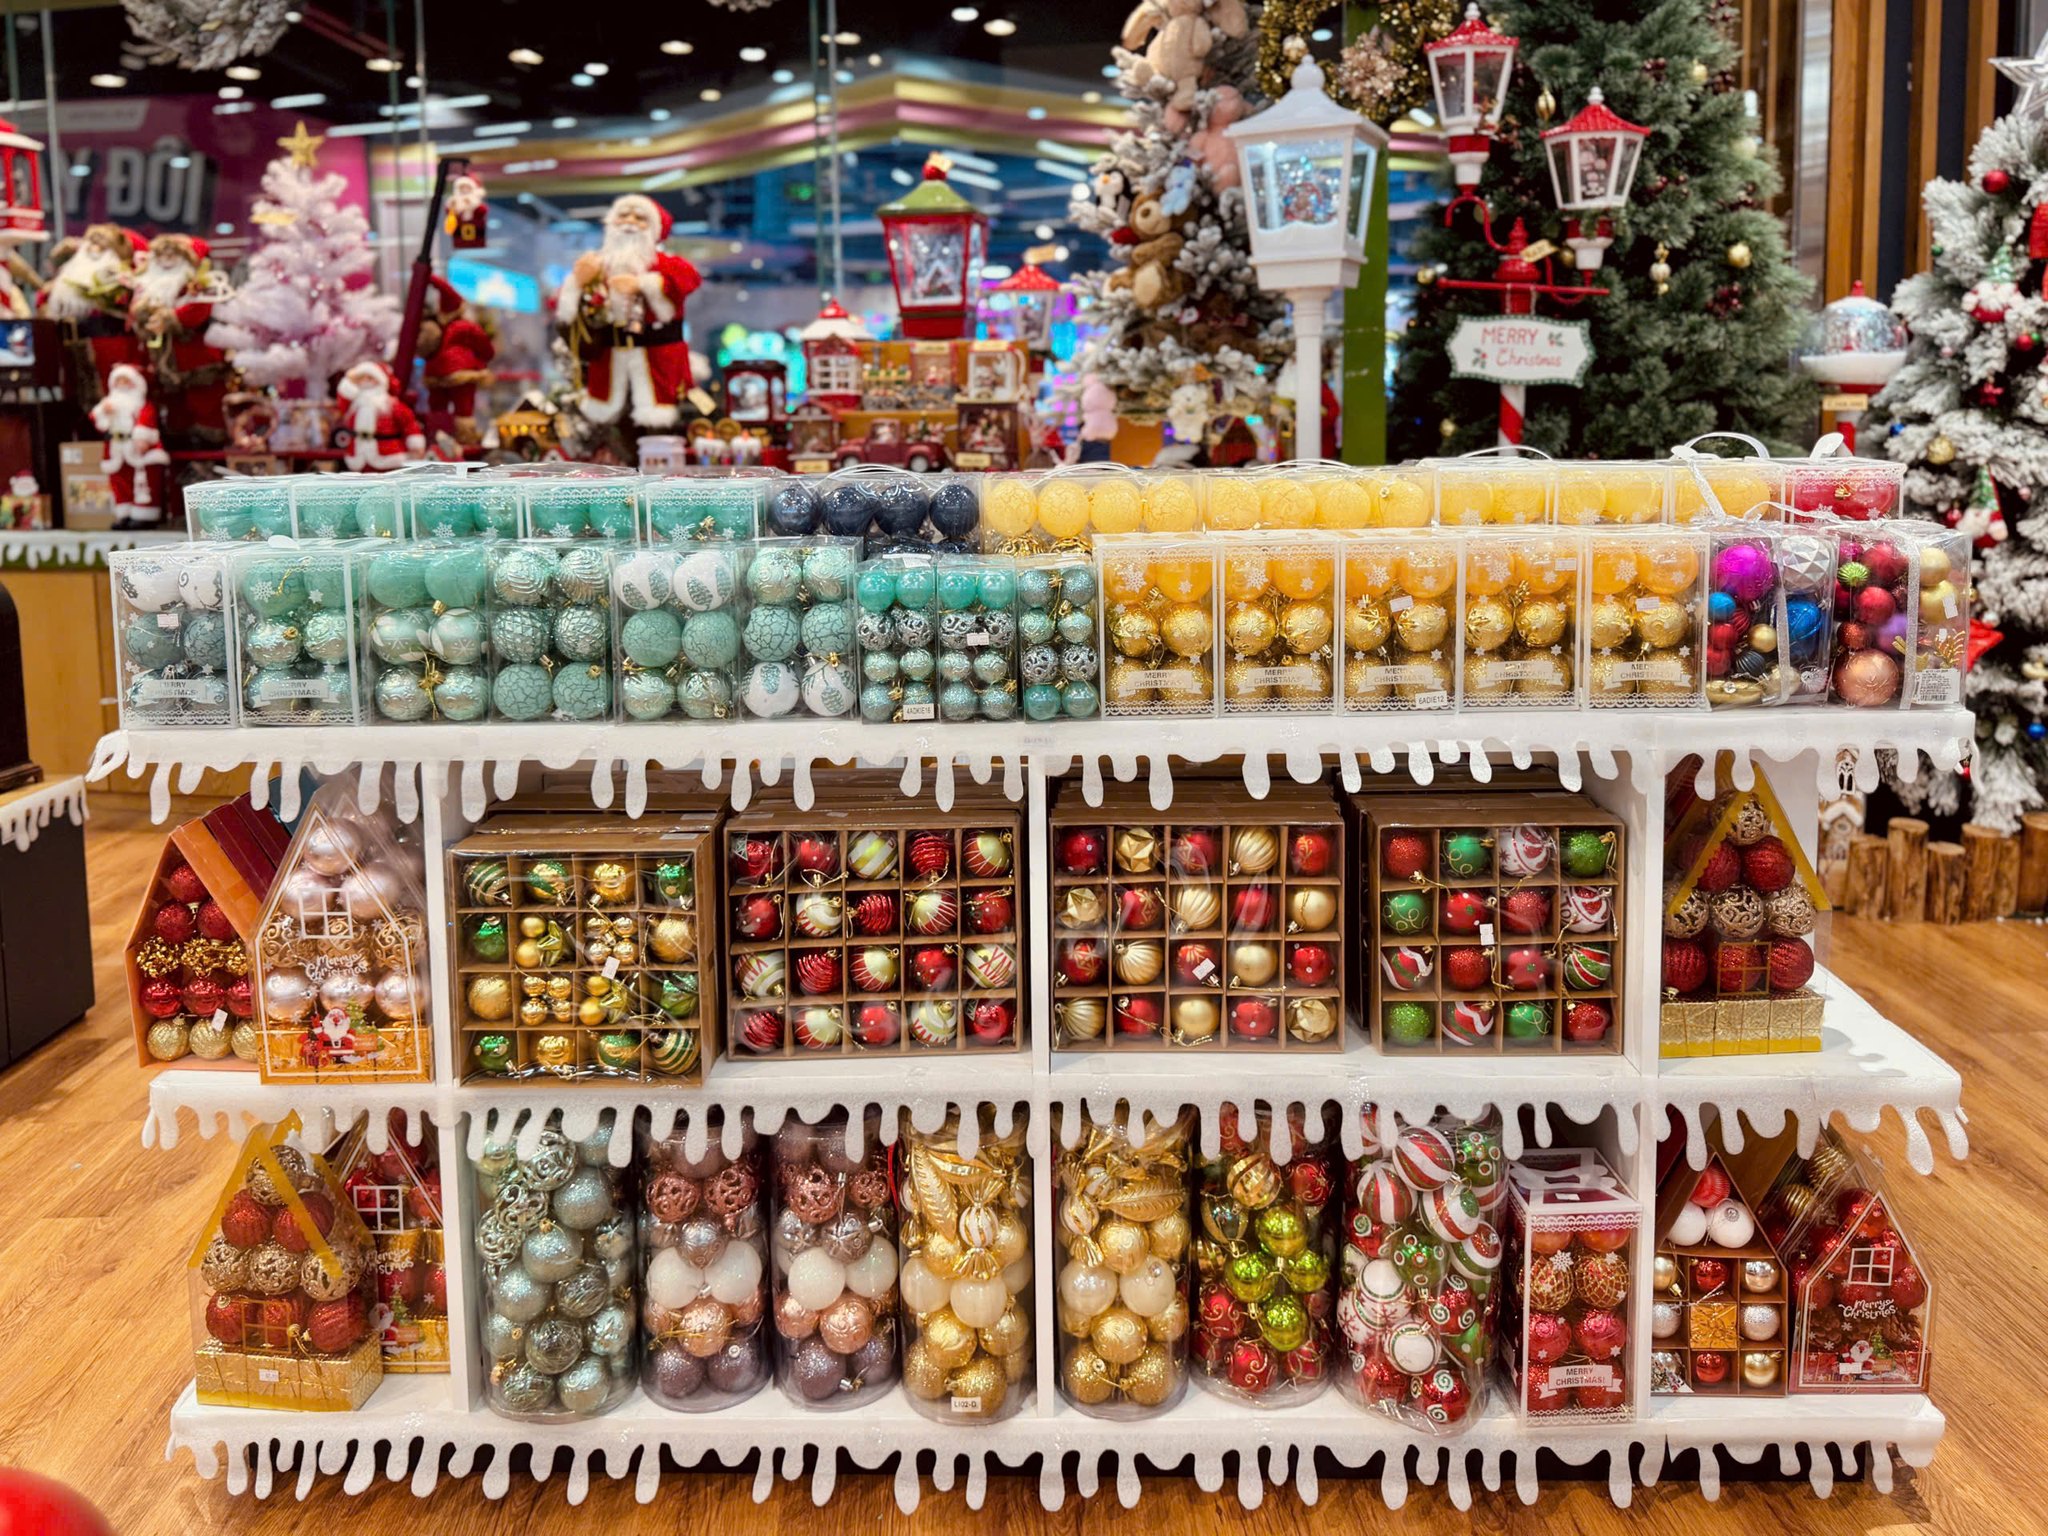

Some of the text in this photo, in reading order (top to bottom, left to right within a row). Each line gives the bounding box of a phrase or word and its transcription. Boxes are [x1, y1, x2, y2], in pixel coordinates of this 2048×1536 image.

[103, 135, 207, 225] ĐÔI
[1481, 327, 1539, 345] MERRY
[1496, 348, 1562, 367] Christmas
[316, 953, 362, 969] Merry
[1838, 1304, 1897, 1320] Christmas
[1854, 1299, 1895, 1312] Merry
[1565, 1368, 1593, 1376] MERRY
